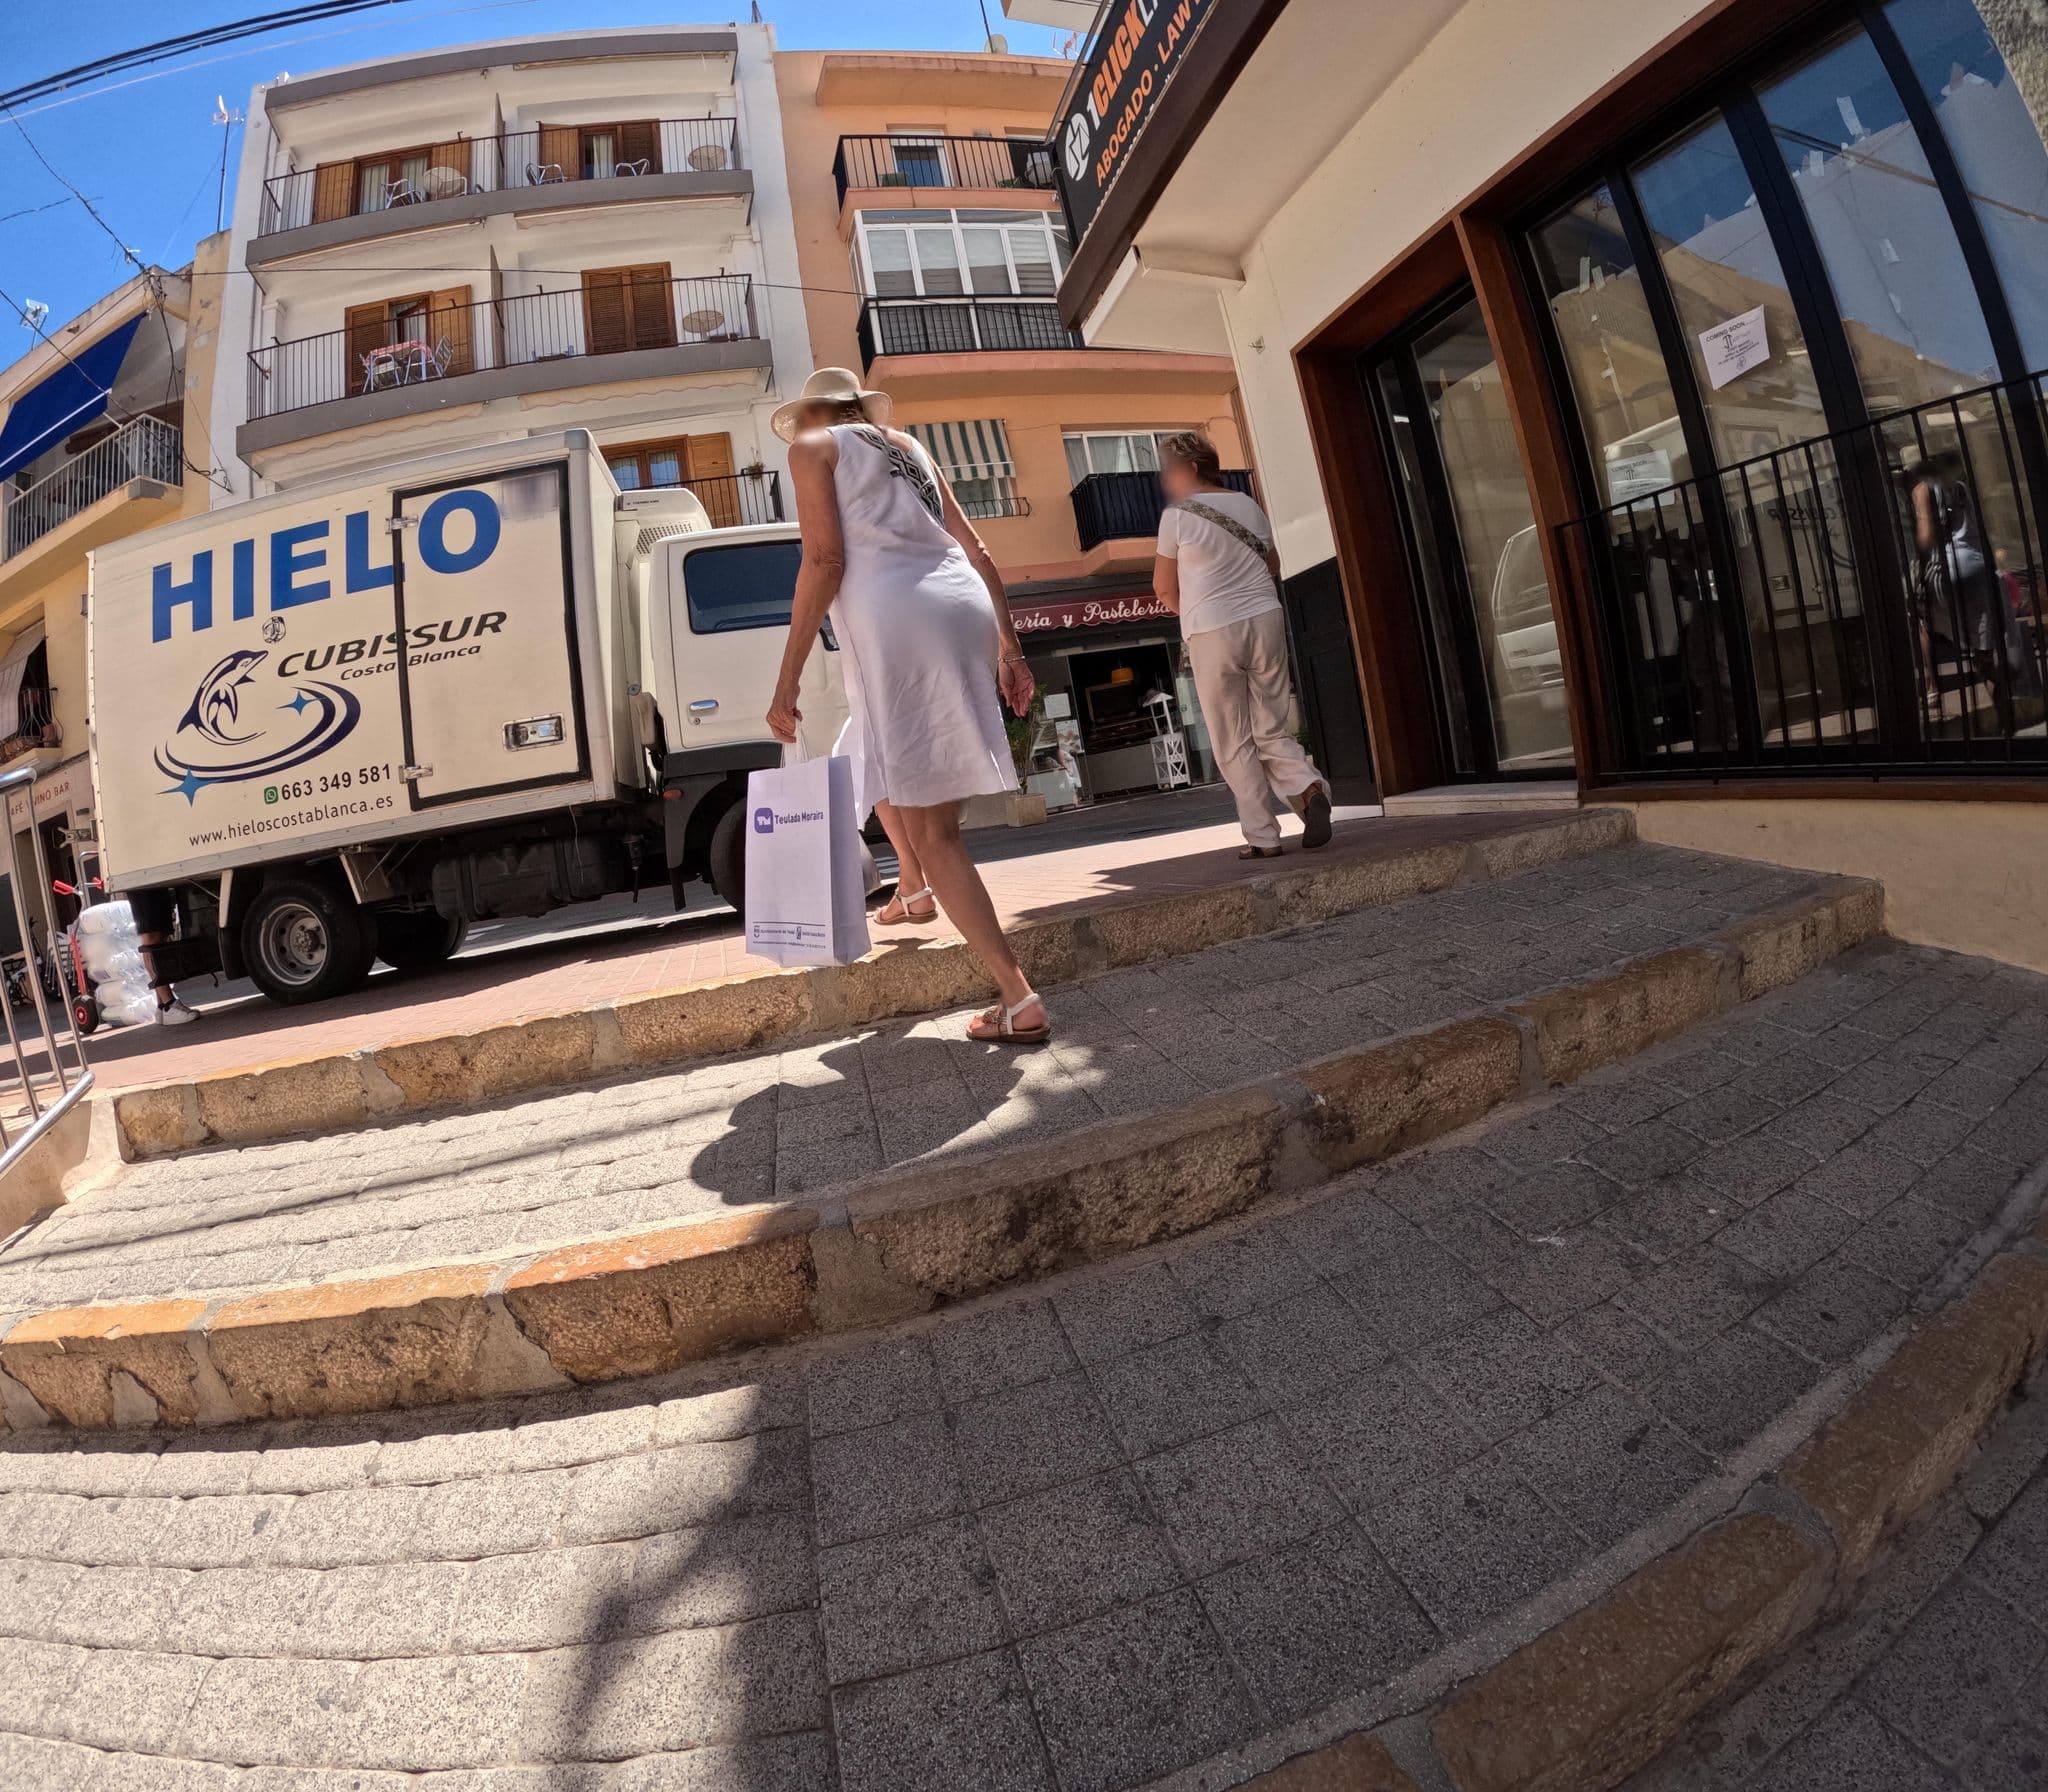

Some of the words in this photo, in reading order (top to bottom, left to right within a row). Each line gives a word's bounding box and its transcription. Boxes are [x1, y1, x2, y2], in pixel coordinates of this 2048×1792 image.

[1087, 0, 1159, 131] 1CLICKL
[1096, 69, 1153, 187] ABOGADO
[1157, 0, 1201, 64] LAW
[1706, 328, 1728, 343] COMING
[152, 489, 501, 643] HIELO
[1062, 614, 1074, 628] y
[277, 611, 507, 678] CUBISSUR
[340, 661, 396, 681] Costa
[408, 645, 482, 667] Blanca
[54, 782, 70, 797] BAR
[281, 779, 313, 800] 663
[319, 771, 352, 793] 349
[358, 763, 391, 785] 581
[189, 795, 393, 847] www.hieloscostablanca.es
[774, 812, 801, 825] Teulada
[801, 811, 824, 822] Moraira
